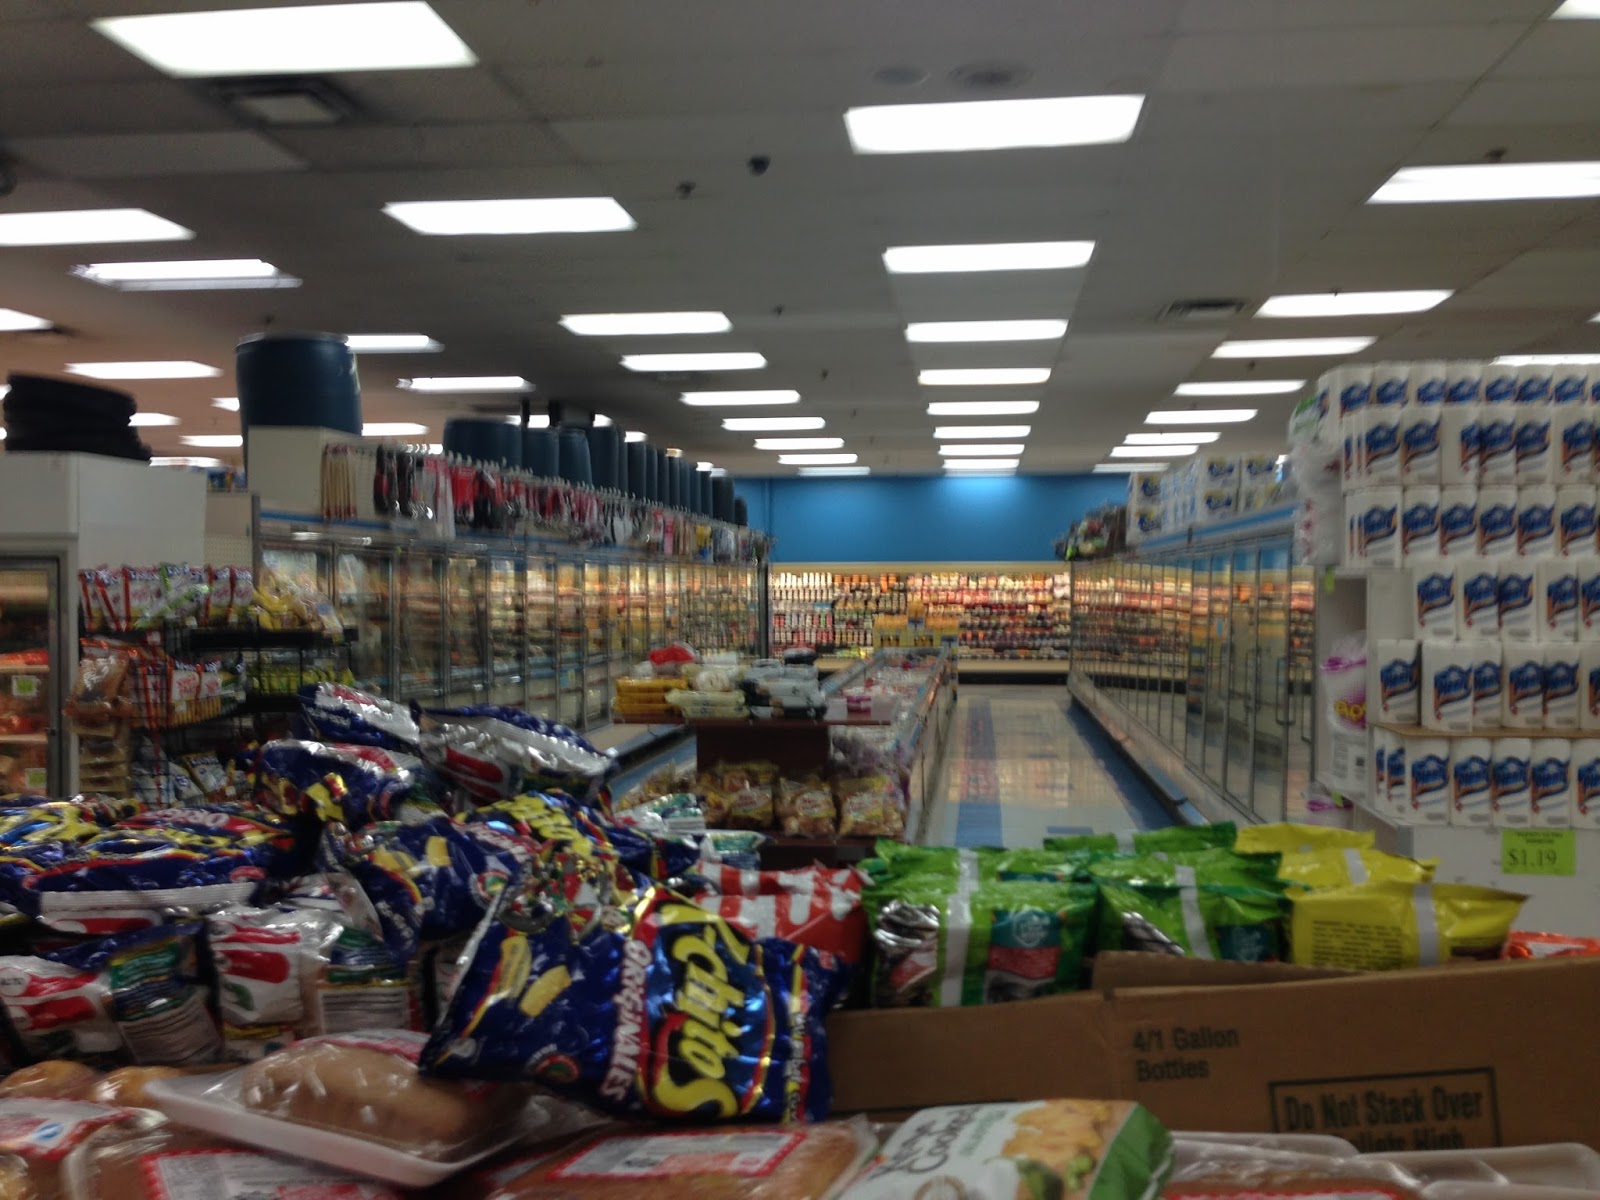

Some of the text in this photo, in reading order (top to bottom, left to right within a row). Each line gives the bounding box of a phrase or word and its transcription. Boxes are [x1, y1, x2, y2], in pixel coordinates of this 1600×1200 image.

[1508, 848, 1557, 867] $1.19
[1133, 1026, 1239, 1053] 4/1 Gallon
[1136, 1058, 1209, 1082] Bottles
[1285, 1085, 1483, 1130] Do Not Stack Over
